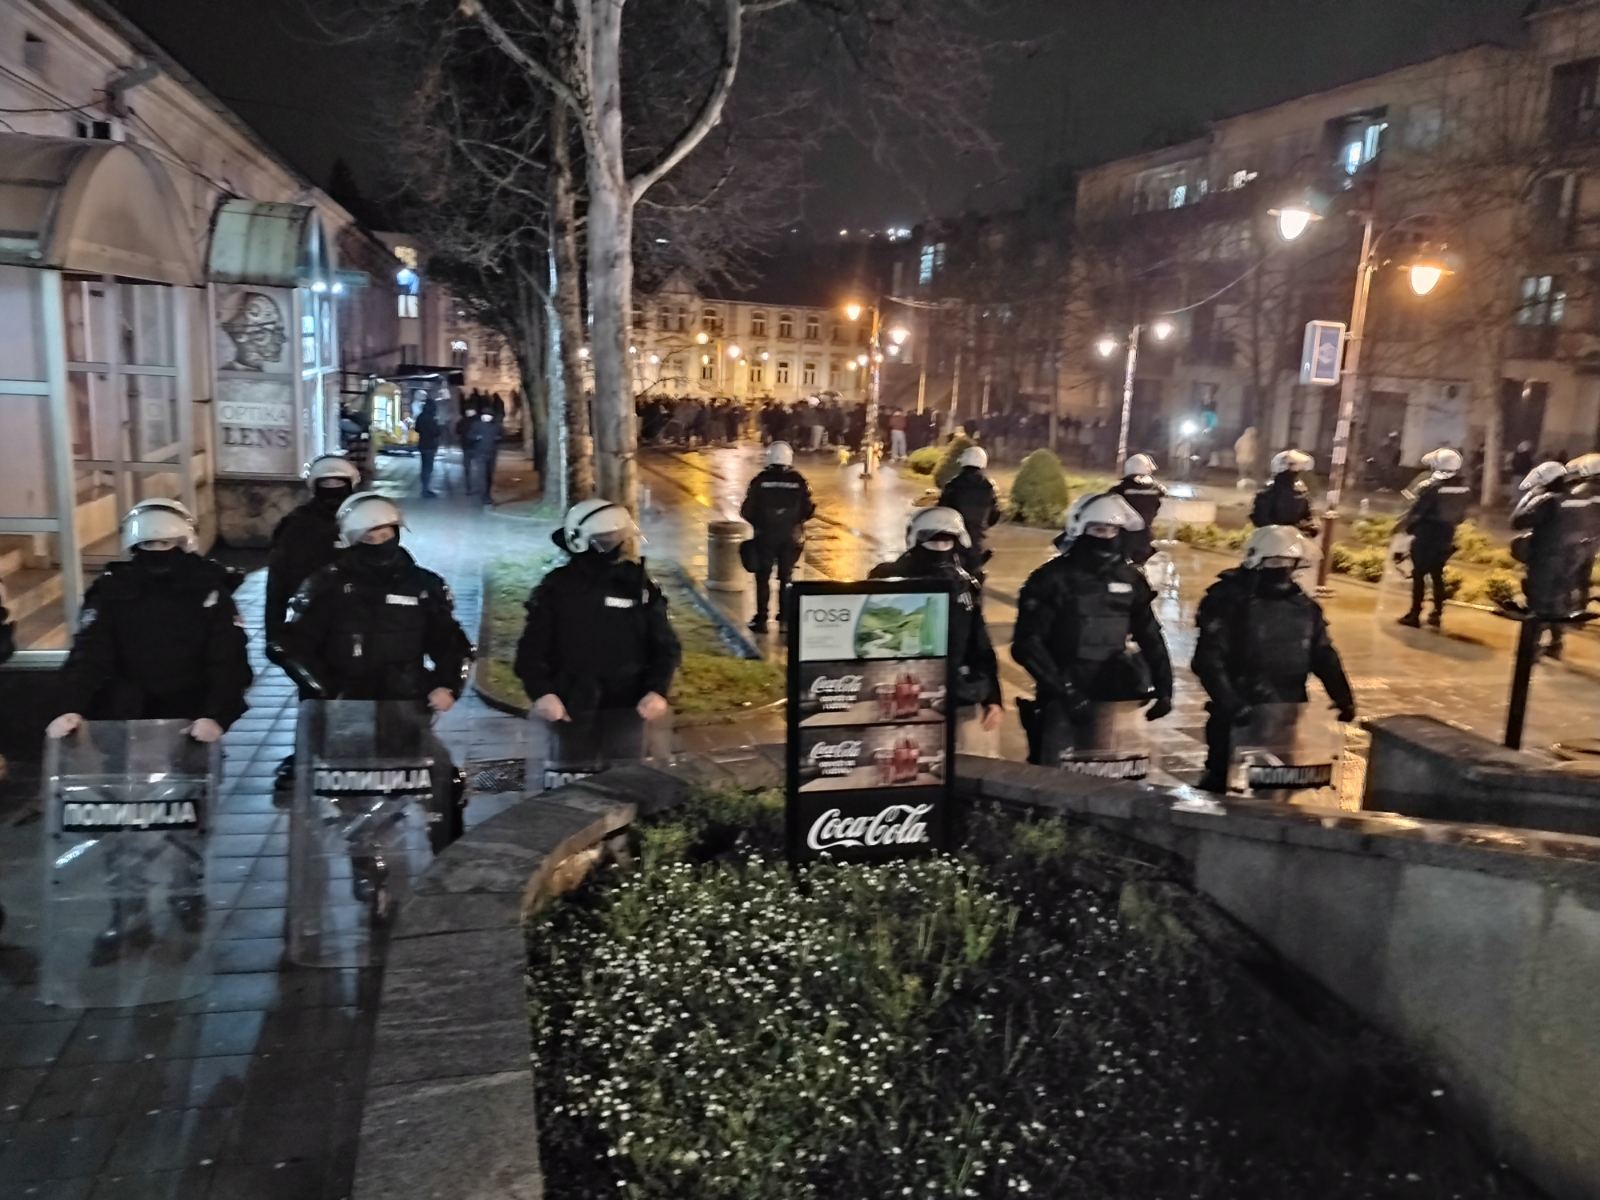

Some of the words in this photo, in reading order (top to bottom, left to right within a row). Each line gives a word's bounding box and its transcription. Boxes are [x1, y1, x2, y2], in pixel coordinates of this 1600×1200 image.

[223, 405, 288, 422] OPTIKA
[222, 426, 289, 448] LENS
[805, 608, 850, 623] rosa
[314, 769, 432, 794] ПОЛИЦИЈА
[64, 801, 197, 829] ПОЛИЦИЈА
[806, 803, 935, 851] Coca-Cola
